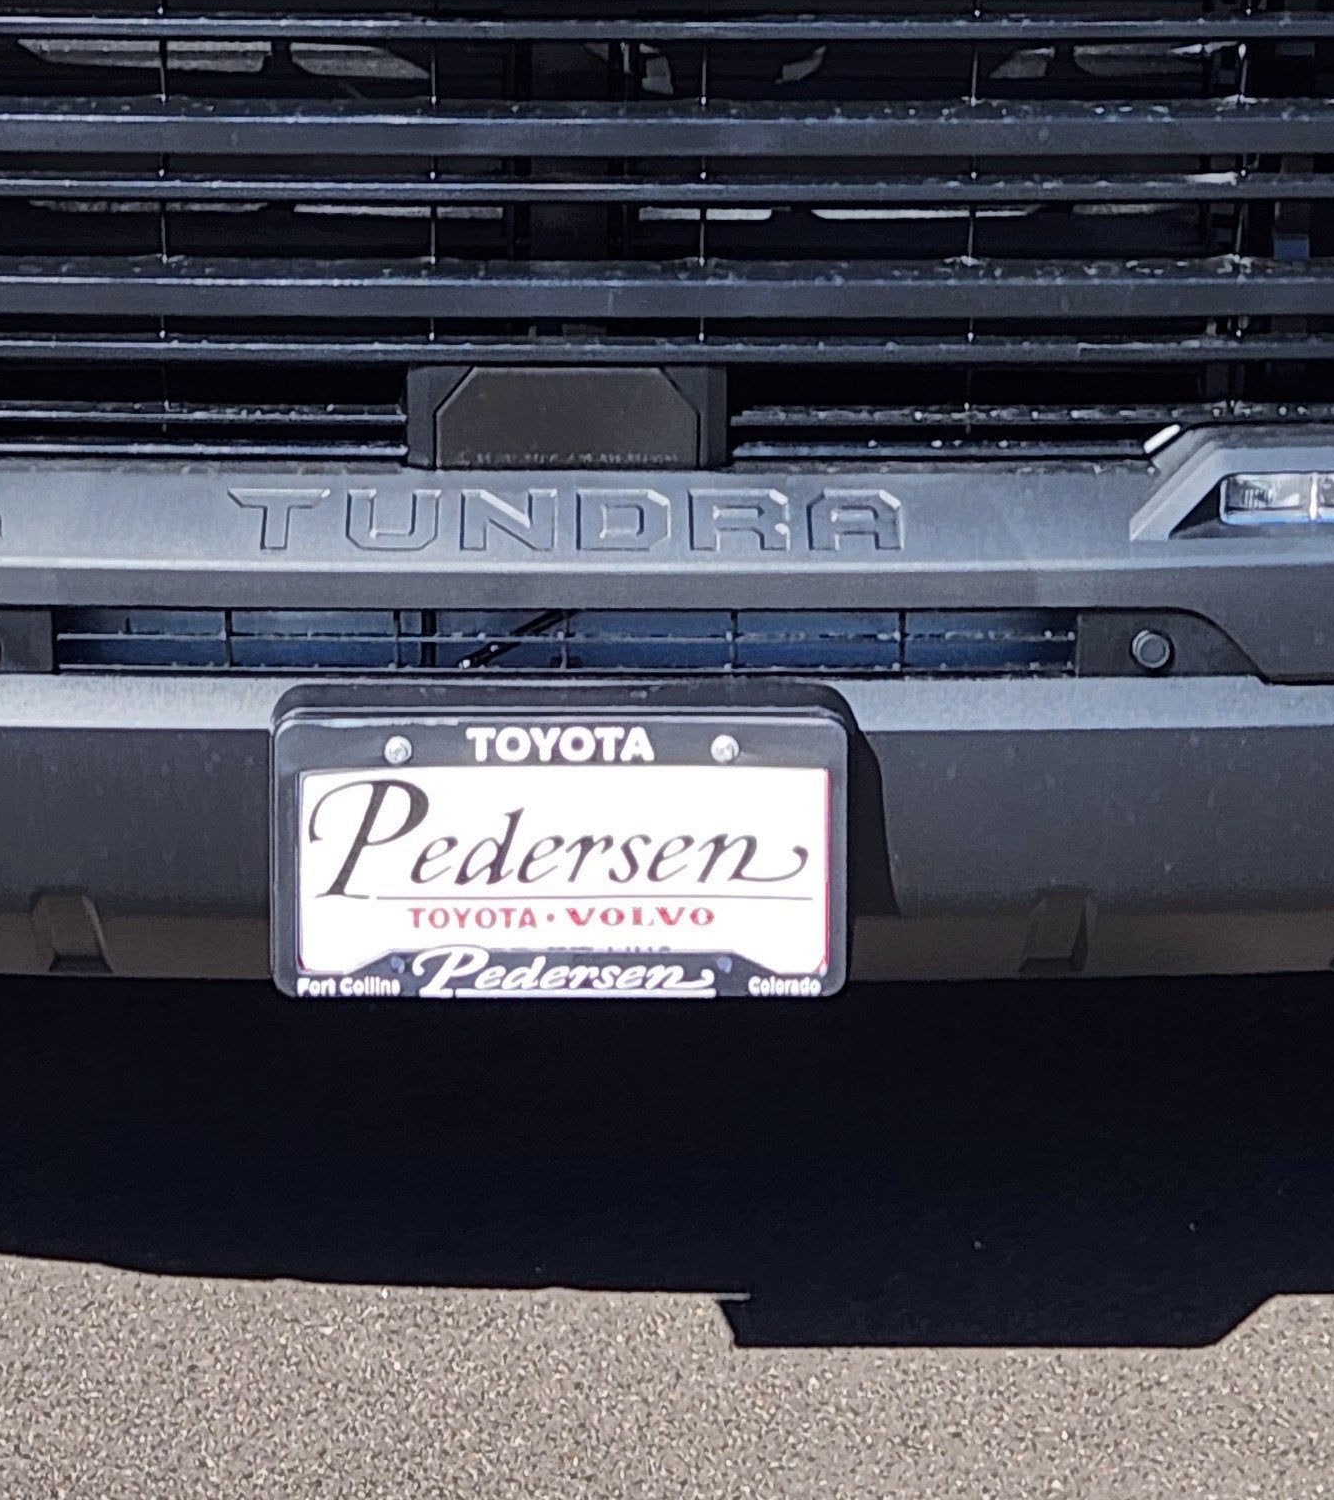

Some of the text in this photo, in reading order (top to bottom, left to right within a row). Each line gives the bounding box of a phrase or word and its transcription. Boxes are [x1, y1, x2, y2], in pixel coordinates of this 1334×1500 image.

[227, 488, 906, 552] TUNDRA
[466, 726, 655, 762] TOYOTA
[308, 779, 810, 900] Pedersen
[407, 906, 716, 929] TOYOTA VOLVO
[296, 975, 401, 997] Fort Collins
[412, 944, 717, 998] Pedersen
[747, 976, 822, 997] Colorado
